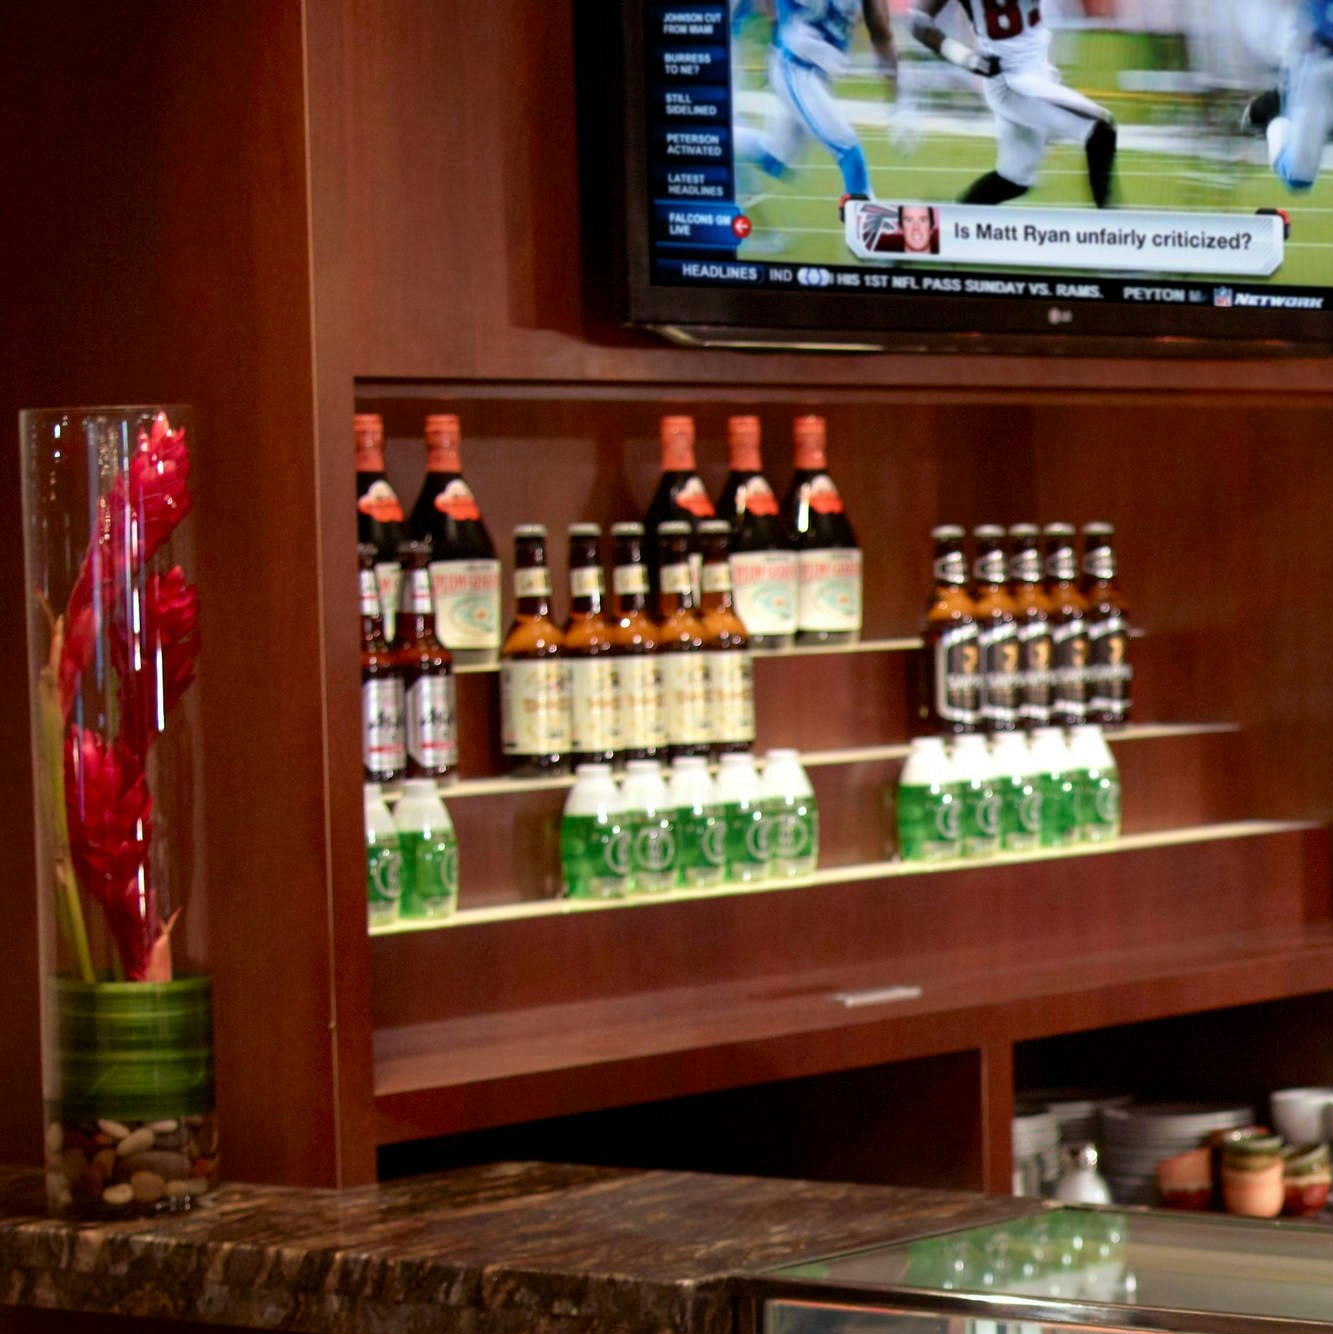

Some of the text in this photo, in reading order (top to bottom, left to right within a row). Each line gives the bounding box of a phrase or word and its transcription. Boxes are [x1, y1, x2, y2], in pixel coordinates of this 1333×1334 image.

[664, 24, 687, 34] FROM
[664, 53, 712, 64] BURRESS
[665, 64, 679, 75] TO
[665, 93, 692, 104] STILL
[666, 105, 718, 116] SIDELINED
[666, 133, 720, 144] PETERSON
[667, 145, 722, 157] ACTIVATED
[668, 173, 706, 184] LATEST
[668, 185, 724, 197] HEADLINES
[669, 212, 714, 226] FALCONS
[669, 225, 691, 236] LIVE
[954, 222, 1253, 251] Is Matt Ryan unfairly criticized?
[682, 264, 758, 281] HEADLINES
[769, 269, 793, 282] IND
[837, 273, 861, 286] HIS
[864, 274, 889, 287] 1ST
[892, 276, 920, 290] NFL
[923, 278, 962, 292] PASS
[964, 280, 1025, 295] SUNDAY
[1028, 284, 1053, 297] VS.
[1056, 285, 1104, 299] RAMS.
[1124, 287, 1186, 302] PEYTON
[1235, 292, 1325, 309] NETWORK
